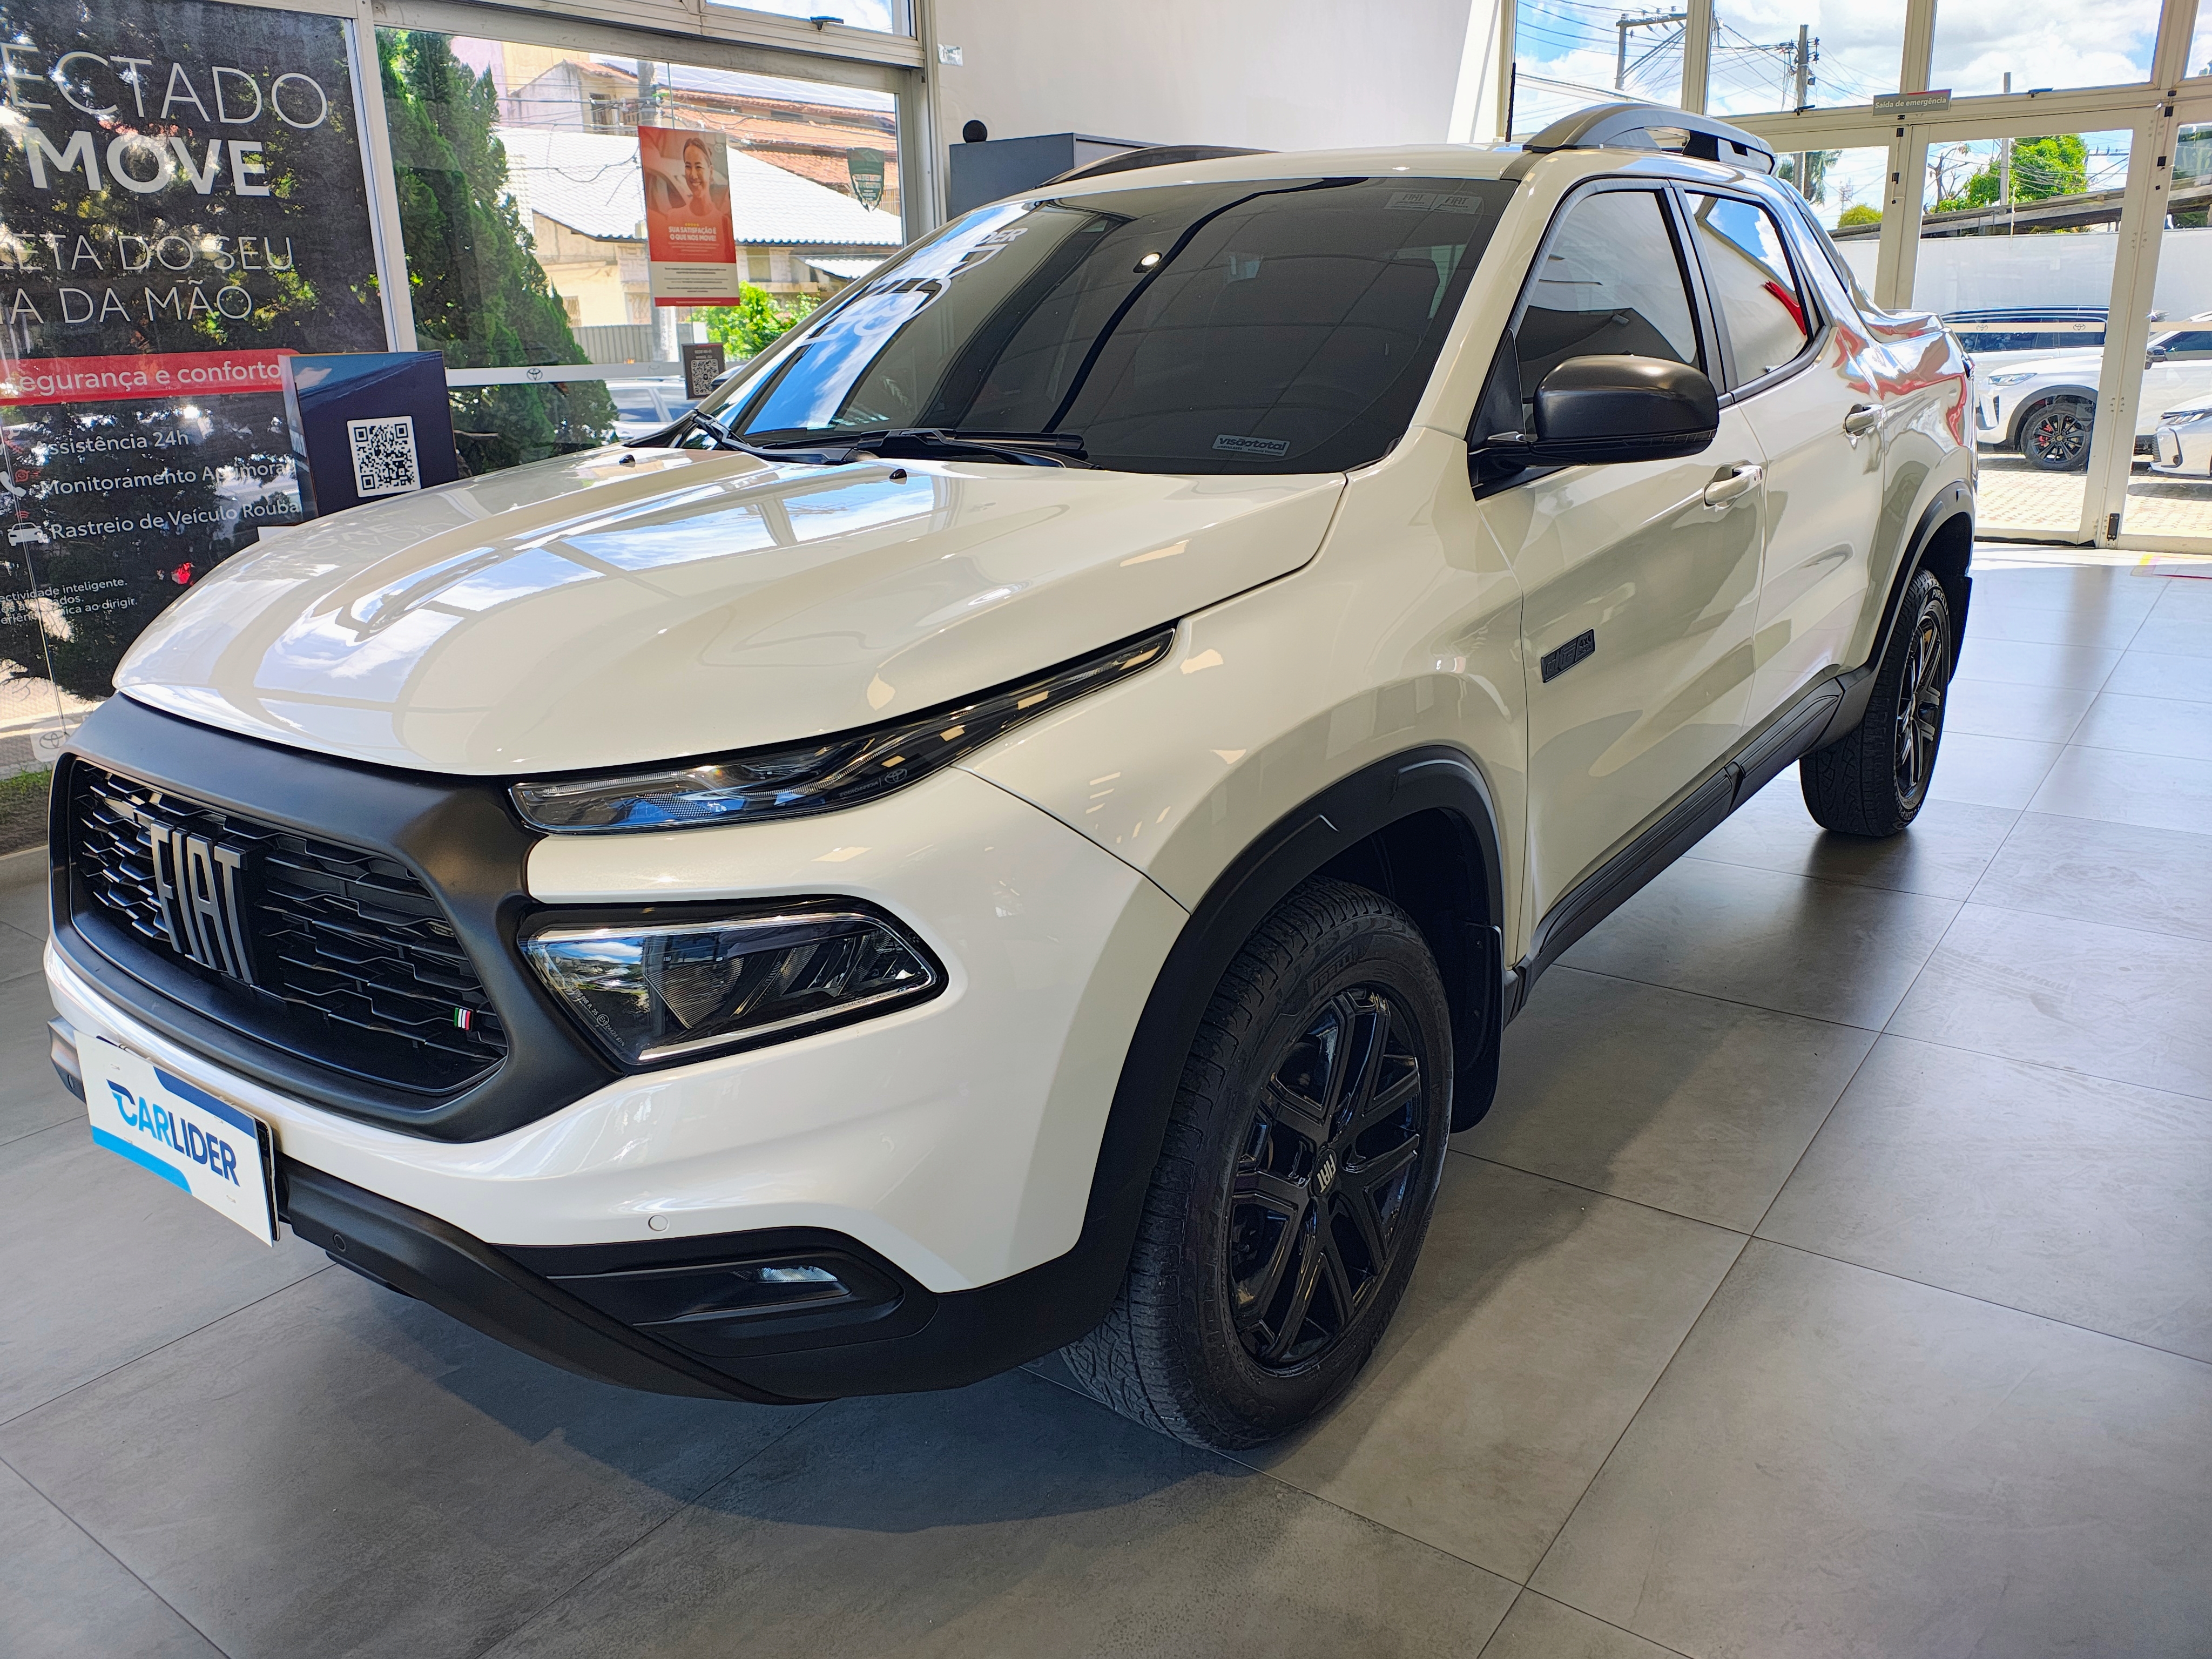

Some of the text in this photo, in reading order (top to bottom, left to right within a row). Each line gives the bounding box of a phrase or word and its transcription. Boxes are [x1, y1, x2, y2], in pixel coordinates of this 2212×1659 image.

[0, 43, 327, 130] ECTADO
[1874, 100, 1893, 109] Saída
[1905, 96, 1946, 107] emergência
[22, 127, 271, 197] MOVE
[1444, 196, 1469, 205] FIAT
[118, 235, 194, 270] DO
[213, 235, 293, 271] SEU
[58, 287, 131, 323] DA
[144, 279, 253, 320] MÃO
[154, 368, 171, 383] e
[176, 360, 282, 382] conforto
[153, 429, 189, 448] 24h
[41, 468, 197, 495] Monitoramento
[51, 498, 301, 541] Rastreio de Veículo Rouba
[62, 578, 128, 594] inteligente.
[150, 822, 254, 986] FIAT
[106, 1078, 241, 1188] CARLIDER
[1317, 1153, 1337, 1193] FIAT
